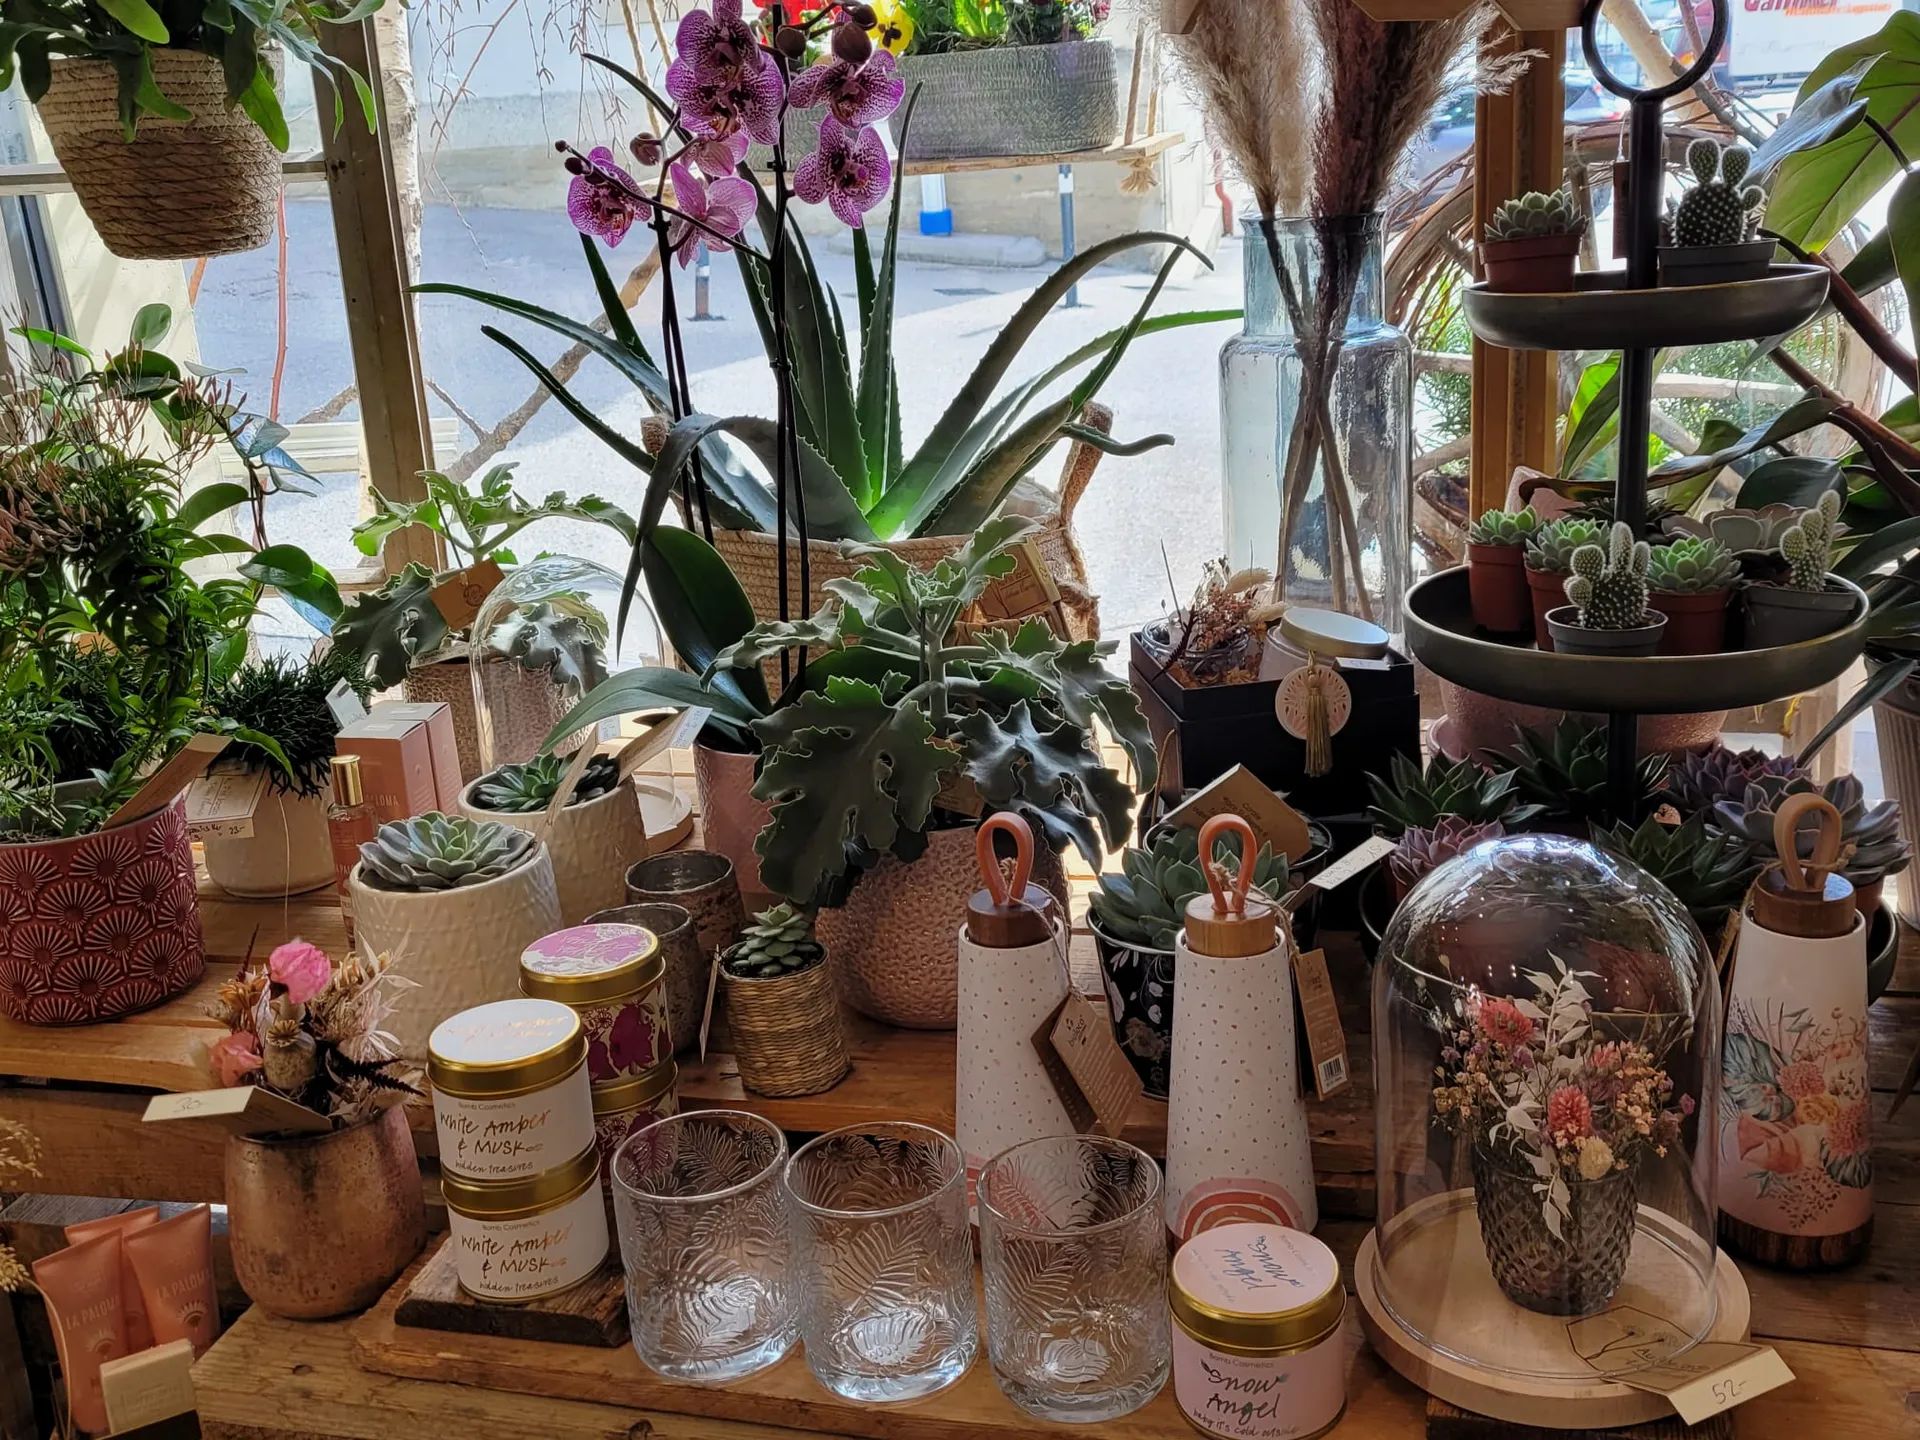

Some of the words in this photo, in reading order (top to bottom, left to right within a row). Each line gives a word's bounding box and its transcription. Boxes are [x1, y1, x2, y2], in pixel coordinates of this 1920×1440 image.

[440, 1111, 479, 1135] White
[483, 1109, 551, 1138] Amber
[457, 1137, 468, 1159] &
[474, 1139, 526, 1157] MUSK
[455, 1160, 487, 1173] hidden
[461, 1233, 505, 1256] White
[509, 1221, 574, 1257] Amber
[481, 1257, 492, 1279] &
[500, 1256, 550, 1275] MUSK
[1206, 1367, 1281, 1395] Snow
[1206, 1393, 1281, 1426] Angel
